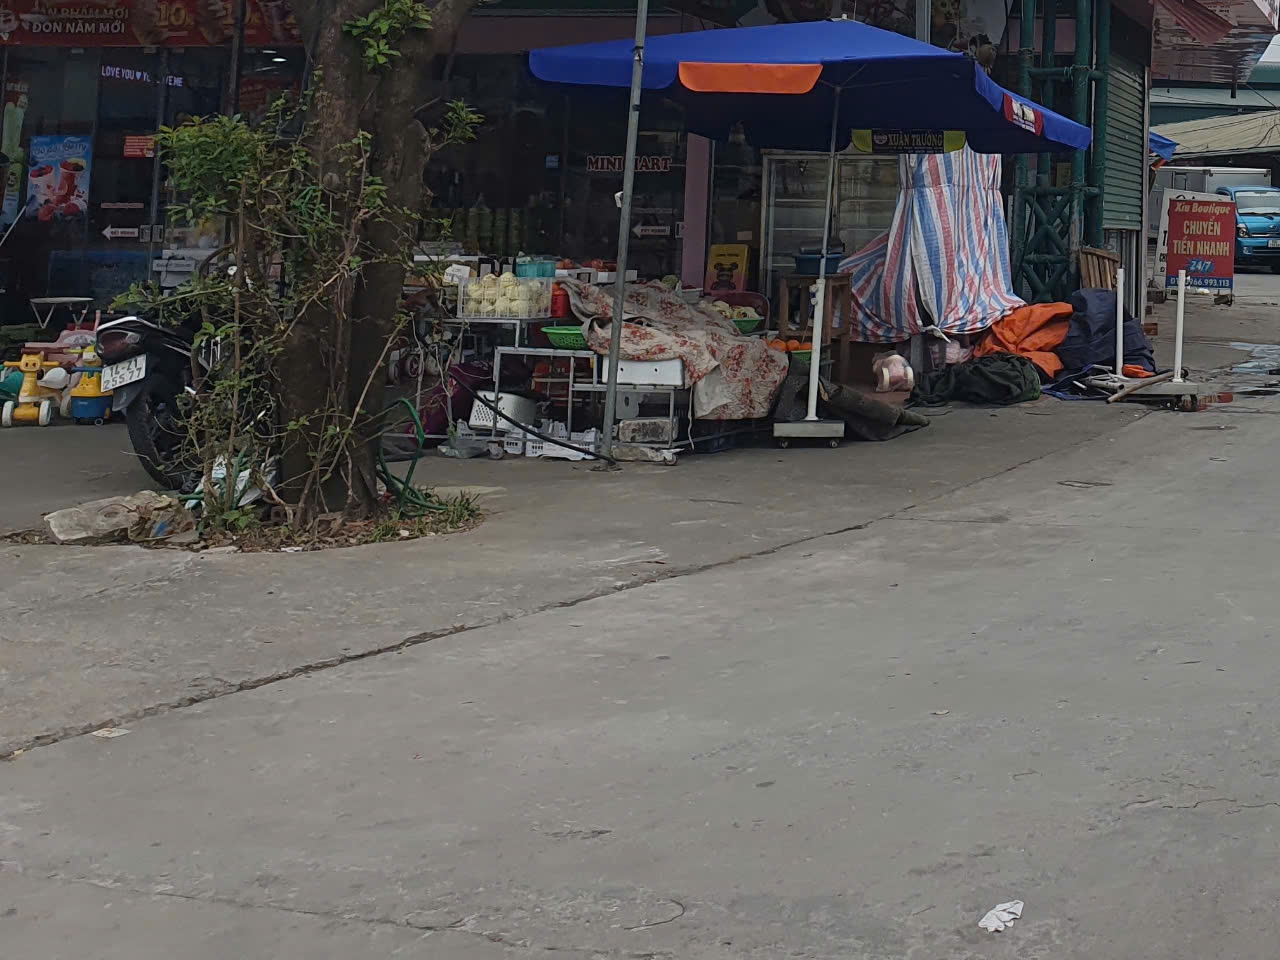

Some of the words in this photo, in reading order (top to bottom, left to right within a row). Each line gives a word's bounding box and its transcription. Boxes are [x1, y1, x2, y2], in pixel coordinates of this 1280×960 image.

[586, 155, 623, 171] MINI
[1191, 202, 1231, 215] Boutique
[1196, 240, 1230, 256] NHANH
[1190, 260, 1211, 271] 24/7
